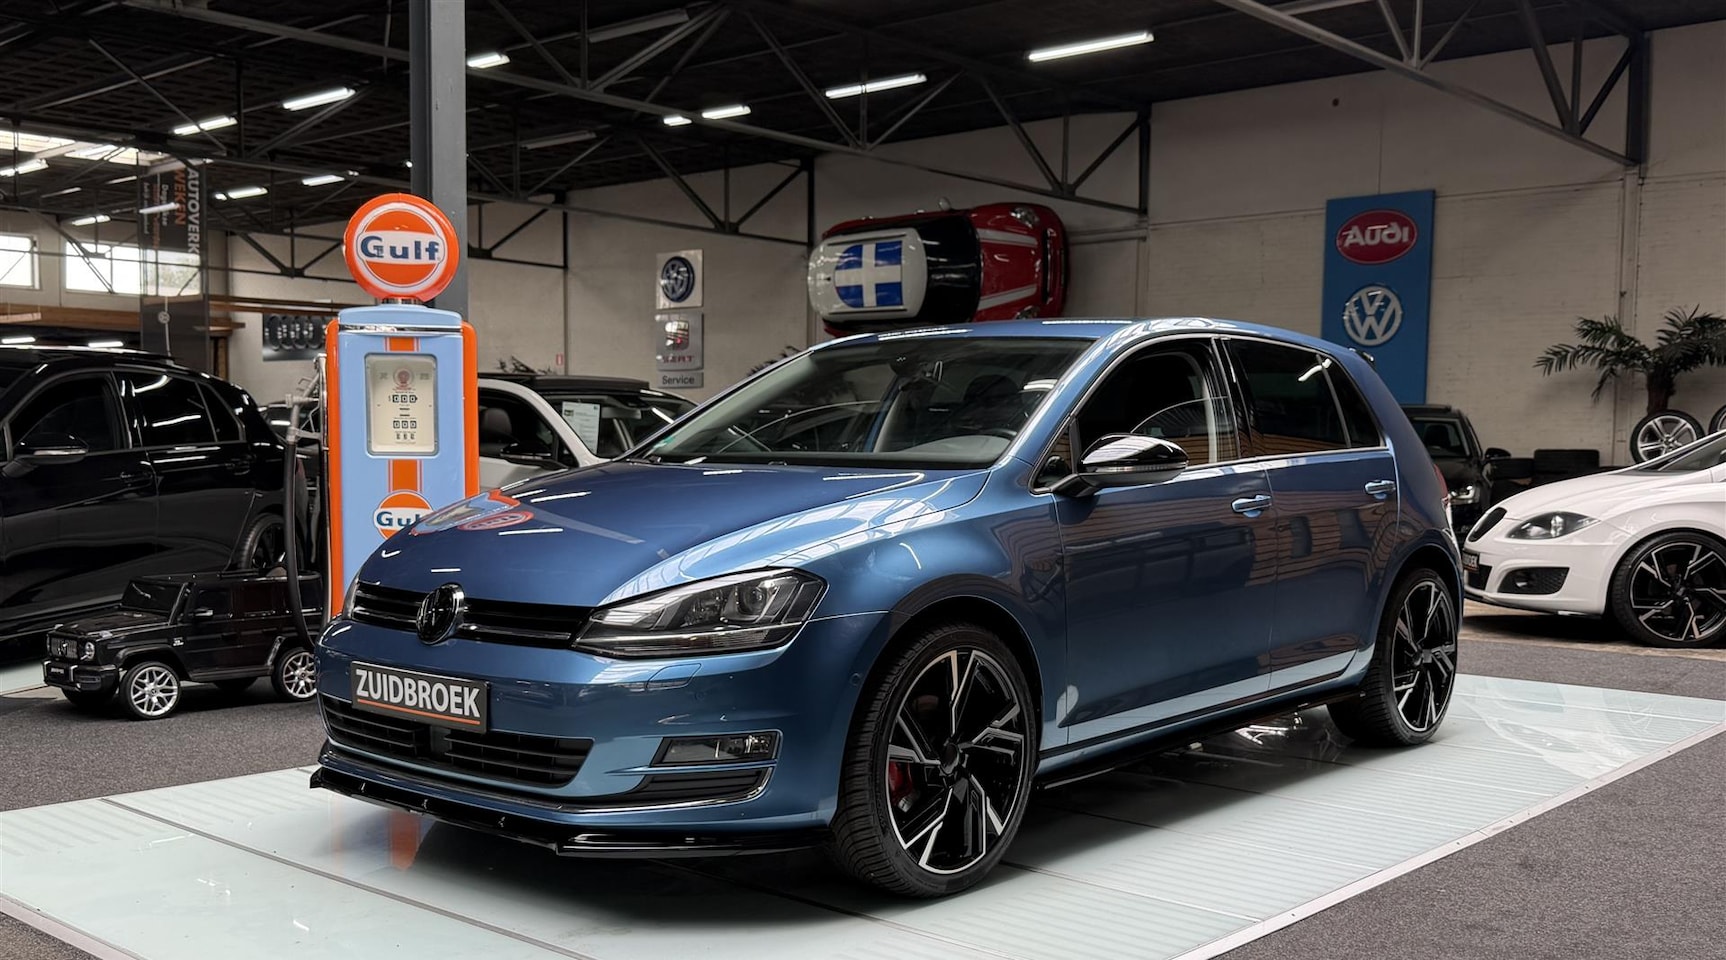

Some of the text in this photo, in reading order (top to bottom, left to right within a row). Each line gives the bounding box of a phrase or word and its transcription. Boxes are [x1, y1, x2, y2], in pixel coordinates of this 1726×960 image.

[360, 235, 440, 260] Gulf
[662, 375, 695, 385] Service
[376, 511, 421, 528] Gul
[356, 668, 480, 718] ZUIDBROEK
